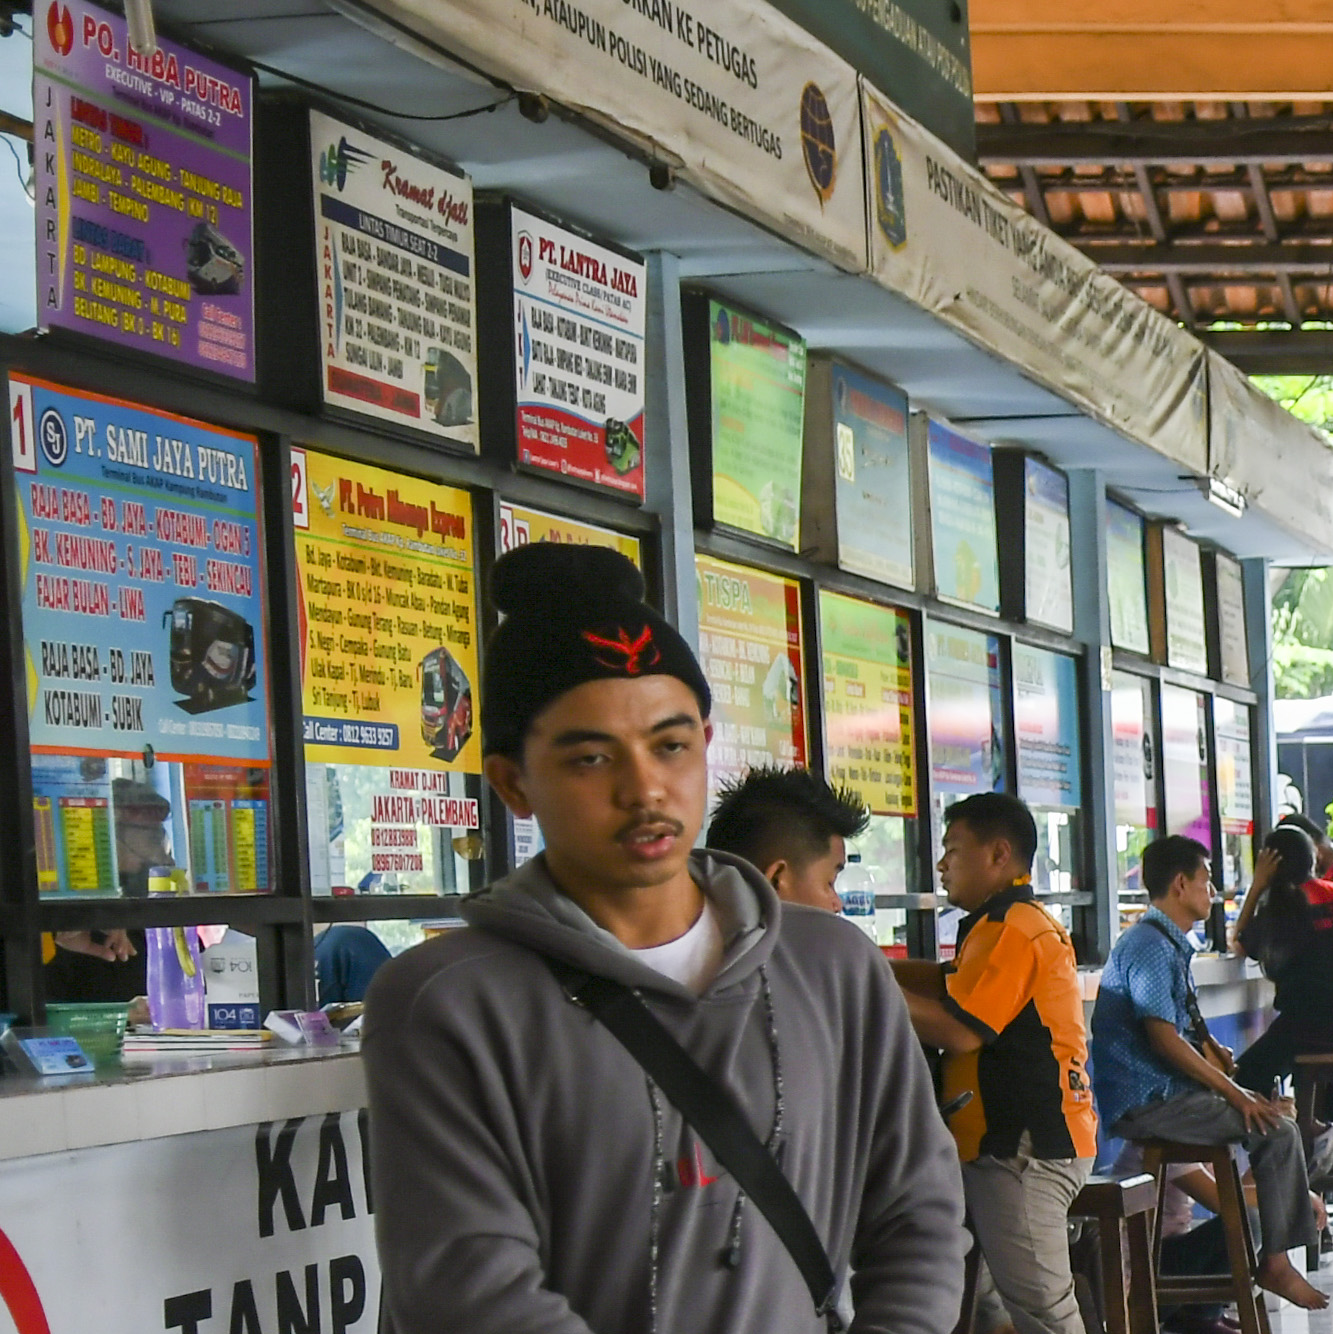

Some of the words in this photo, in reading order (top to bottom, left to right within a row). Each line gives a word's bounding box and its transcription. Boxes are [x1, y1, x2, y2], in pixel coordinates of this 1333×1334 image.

[83, 14, 121, 63] PO.
[127, 33, 181, 91] HIBA
[184, 65, 244, 119] PUTRA
[543, 0, 607, 49] ATAUPUN
[610, 30, 648, 78] POLISI
[650, 54, 683, 99] YANG
[684, 78, 729, 129] SEDANG
[730, 112, 784, 161] BERTUGAS
[677, 16, 696, 49] KE
[698, 21, 759, 90] PETUGAS
[105, 64, 153, 96] EXECUTIVE
[160, 90, 175, 106] VIP
[181, 97, 206, 121] PATAS
[207, 109, 221, 127] 2-2
[44, 87, 58, 310] JAKARTA
[381, 159, 435, 211] Kramat
[437, 190, 469, 226] djati
[926, 155, 982, 225] PASTIKAN
[983, 198, 1009, 250] TIKET
[358, 213, 384, 238] LINTAS
[385, 223, 409, 247] TIMUR
[427, 240, 439, 262] 2-2
[539, 236, 557, 266] PT.
[560, 245, 608, 287] LANTRA
[610, 267, 638, 298] JAYA
[12, 395, 27, 456] 1
[73, 415, 102, 458] PT.
[106, 424, 149, 469] SAMI
[153, 436, 195, 480] JAYA
[198, 445, 249, 491] PUTRA
[30, 483, 61, 522] RAJA
[62, 488, 91, 527] BASA
[101, 495, 120, 533] BD.
[121, 500, 148, 538] JAYA
[212, 519, 243, 556] OGAN
[291, 462, 304, 515] 2
[32, 526, 54, 565] BK.
[55, 531, 118, 576] KEMUNING
[127, 543, 139, 579] S.
[139, 547, 165, 584] JAYA
[172, 552, 199, 590] TEBU
[205, 558, 253, 598] SEKINCAU
[36, 573, 71, 612] FAJAR
[72, 578, 110, 618] BULAN
[119, 586, 147, 623] LIWA
[704, 572, 753, 615] TISPA
[41, 640, 71, 679] RAJA
[71, 643, 101, 684] BASA
[109, 647, 129, 687] BD.
[130, 650, 156, 689] JAYA
[43, 689, 103, 730] KOTABUMI
[112, 696, 145, 733] SUBIK
[371, 796, 415, 823] JAKARTA
[421, 798, 478, 827] PALEMBANG
[389, 770, 421, 791] KRAMAT
[422, 772, 447, 793] DJATI
